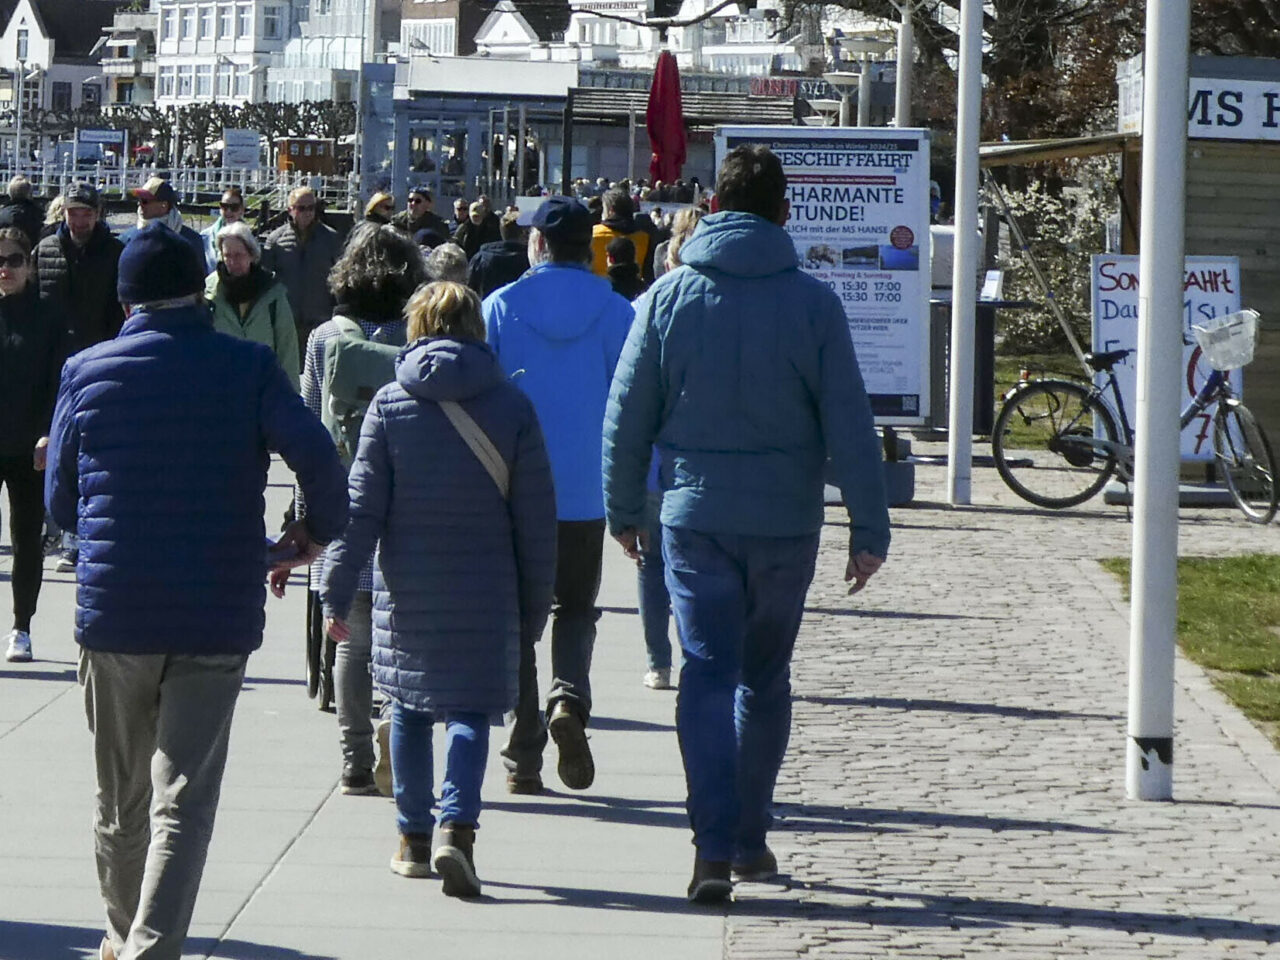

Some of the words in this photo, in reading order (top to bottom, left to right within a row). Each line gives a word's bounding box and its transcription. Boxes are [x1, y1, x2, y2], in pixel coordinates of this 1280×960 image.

[809, 225, 824, 233] mit
[858, 226, 888, 234] HANSE
[842, 282, 868, 291] 15:30
[874, 282, 902, 291] 17:00
[842, 292, 868, 301] 15:30
[874, 292, 902, 302] 17:00
